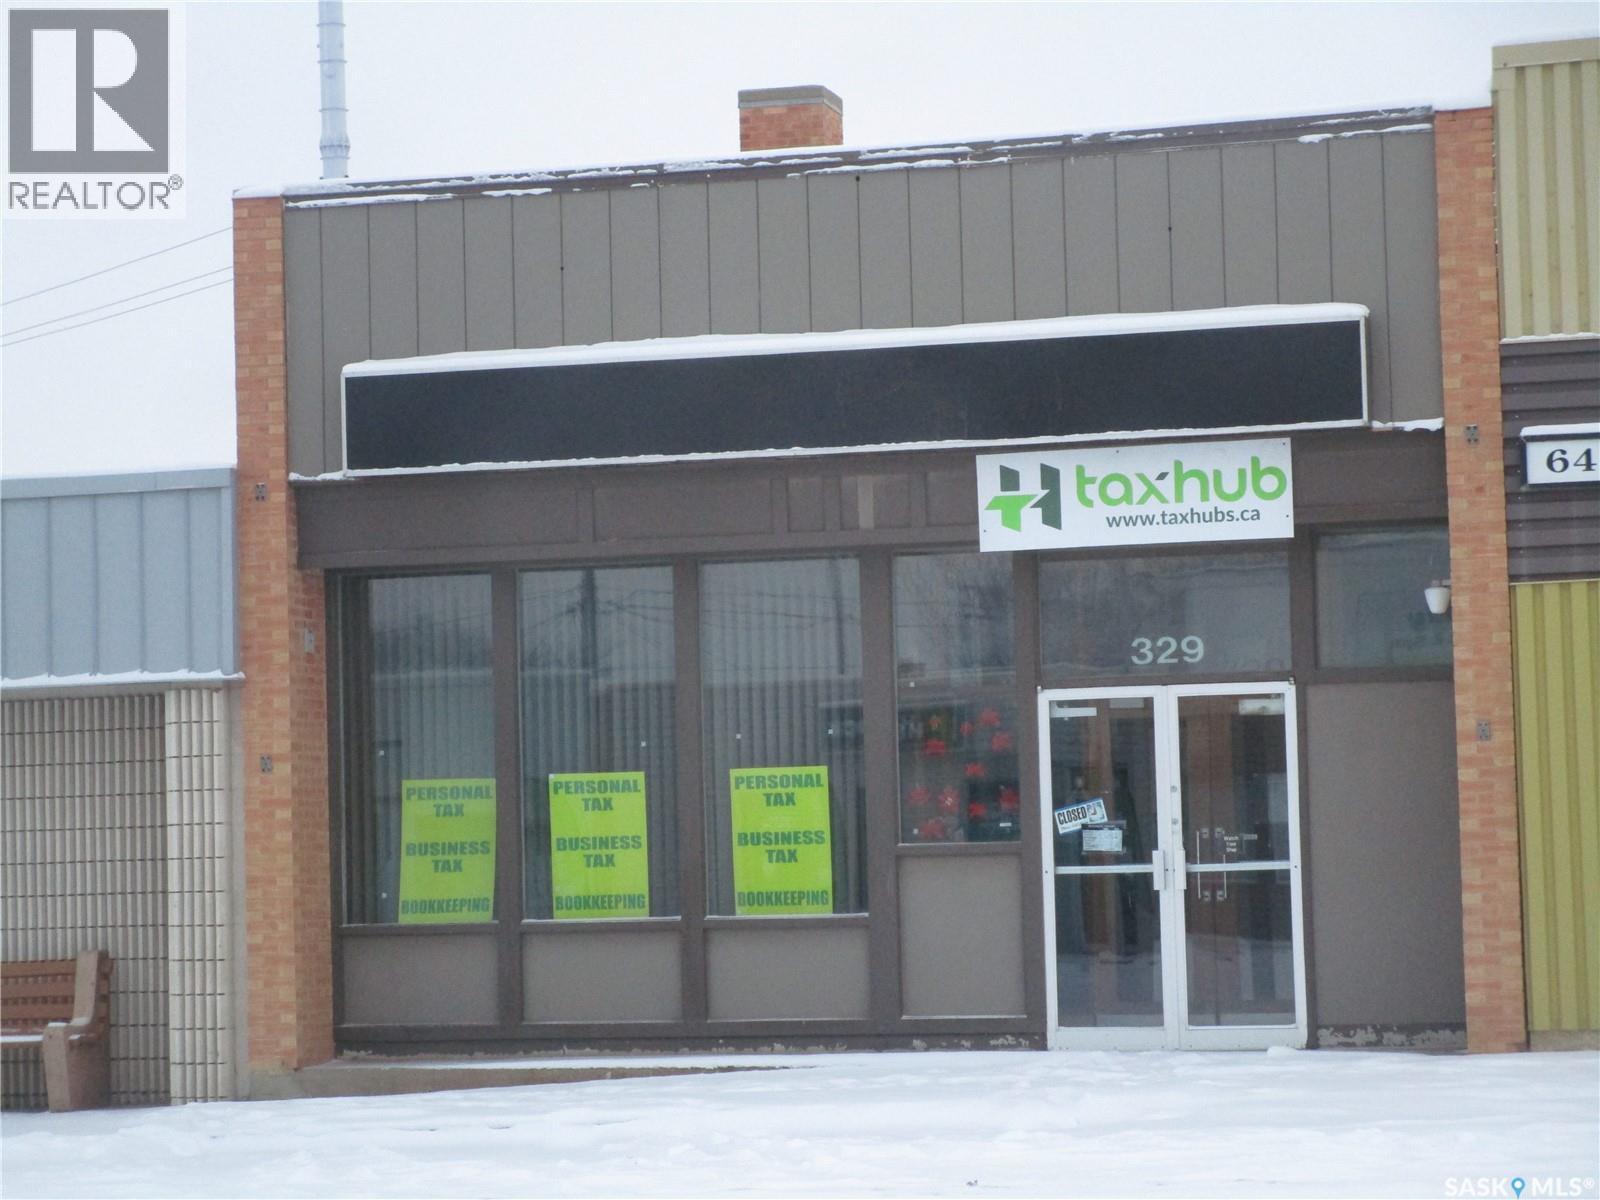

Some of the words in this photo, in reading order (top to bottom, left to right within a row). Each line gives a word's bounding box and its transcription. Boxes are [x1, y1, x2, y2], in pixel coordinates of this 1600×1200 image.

[1546, 448, 1597, 473] 64
[1075, 455, 1287, 509] taxhub
[1106, 506, 1261, 528] www.taxhubs.ca
[1131, 635, 1205, 665] 329
[553, 779, 641, 795] PERSONAL
[735, 773, 824, 790] PERSONAL
[406, 785, 493, 800] PERSONAL
[763, 792, 796, 807] TAX
[433, 803, 465, 818] TAX
[582, 797, 614, 812] TAX
[1057, 806, 1088, 825] CLOSED
[556, 835, 642, 851] BUSINESS
[737, 830, 826, 847] BUSINESS
[406, 840, 490, 857] BUSINESS
[765, 849, 798, 864] TAX
[431, 859, 463, 873] TAX
[583, 853, 616, 868] TAX
[401, 897, 490, 914] BOOKKEEPING
[555, 893, 646, 911] BOOKKEEPING
[736, 890, 829, 907] BOOKKEEPING
